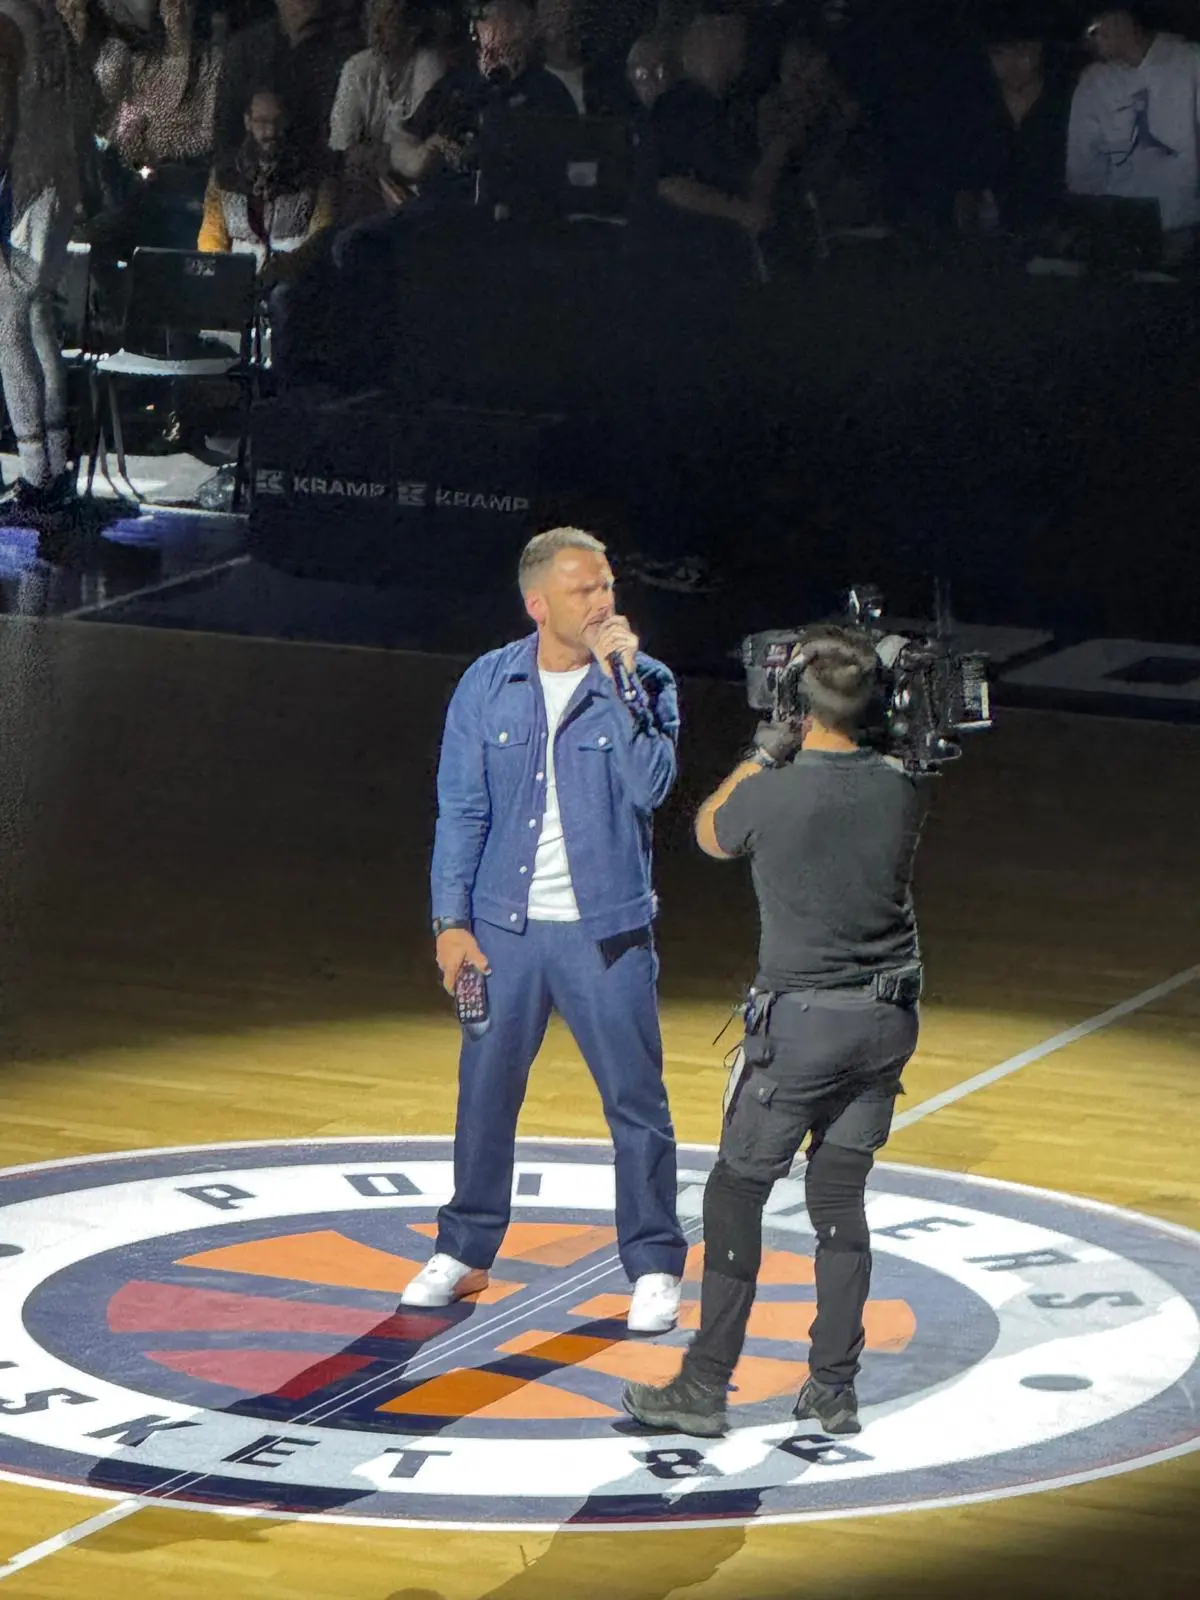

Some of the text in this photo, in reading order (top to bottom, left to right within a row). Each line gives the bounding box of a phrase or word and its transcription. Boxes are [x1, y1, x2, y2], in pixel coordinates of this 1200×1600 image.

[293, 476, 387, 497] KRAMP
[0, 1361, 876, 1480] SKET 86
